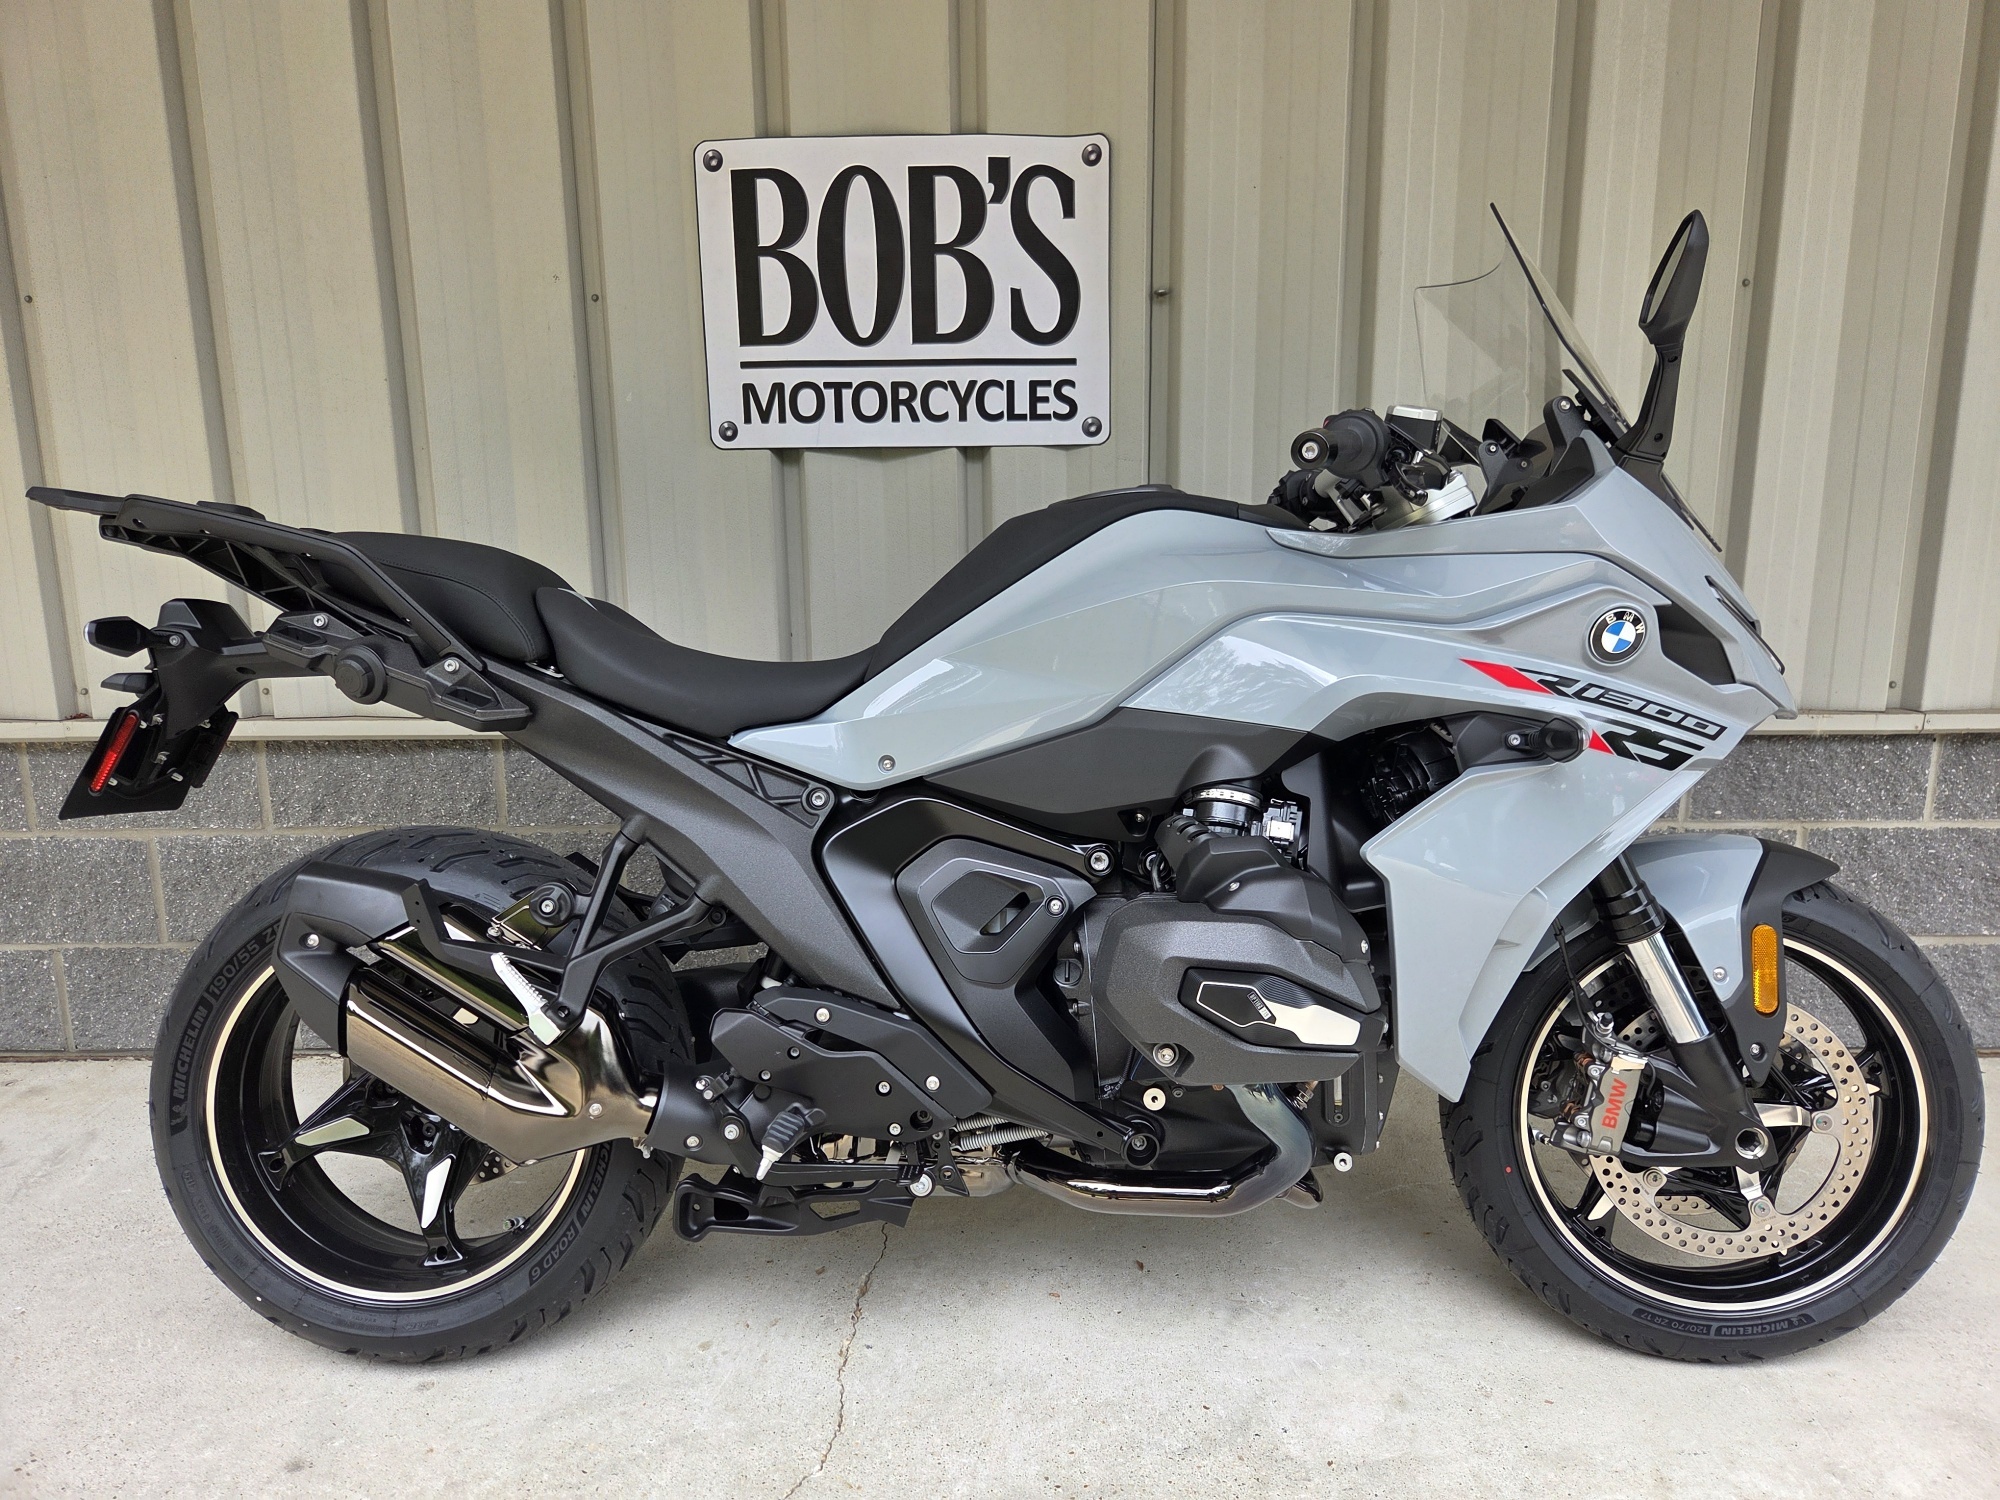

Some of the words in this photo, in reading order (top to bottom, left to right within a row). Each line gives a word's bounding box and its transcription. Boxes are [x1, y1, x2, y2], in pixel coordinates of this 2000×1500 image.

[730, 156, 1081, 347] BOB'S
[741, 379, 1078, 424] MOTORCYCLES
[1605, 610, 1646, 635] BMW
[173, 1007, 209, 1099] MICHELIN
[208, 942, 260, 996] 190/55
[1602, 1078, 1627, 1129] BMW
[581, 1140, 611, 1218] ICHELIN
[543, 1229, 577, 1269] ROAD
[531, 1267, 539, 1281] 6
[1653, 1316, 1670, 1327] ZR
[1671, 1321, 1708, 1334] 120/70
[1721, 1320, 1789, 1335] MICHELIN
